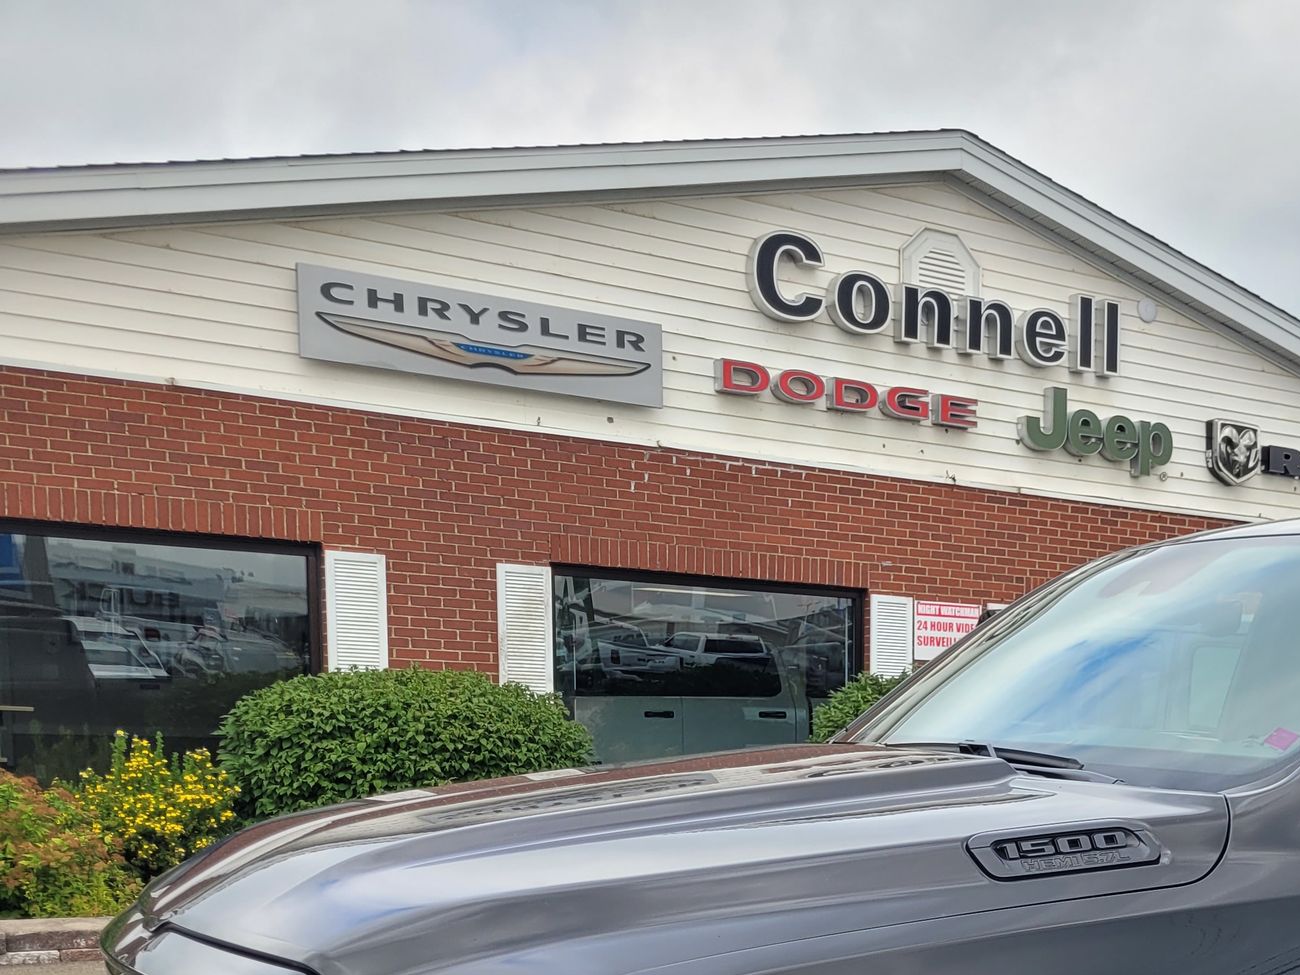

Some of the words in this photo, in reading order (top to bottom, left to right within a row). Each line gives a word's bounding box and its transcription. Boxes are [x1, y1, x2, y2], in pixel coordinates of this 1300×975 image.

[319, 282, 647, 353] CHRYSLER
[746, 229, 1121, 377] Connell
[714, 357, 979, 429] DODGE
[1017, 386, 1173, 478] Jeep
[917, 620, 928, 631] 24
[930, 621, 954, 633] HOUR
[956, 623, 976, 634] VIDE
[998, 831, 1128, 860] 1500
[1021, 853, 1082, 872] HEMI
